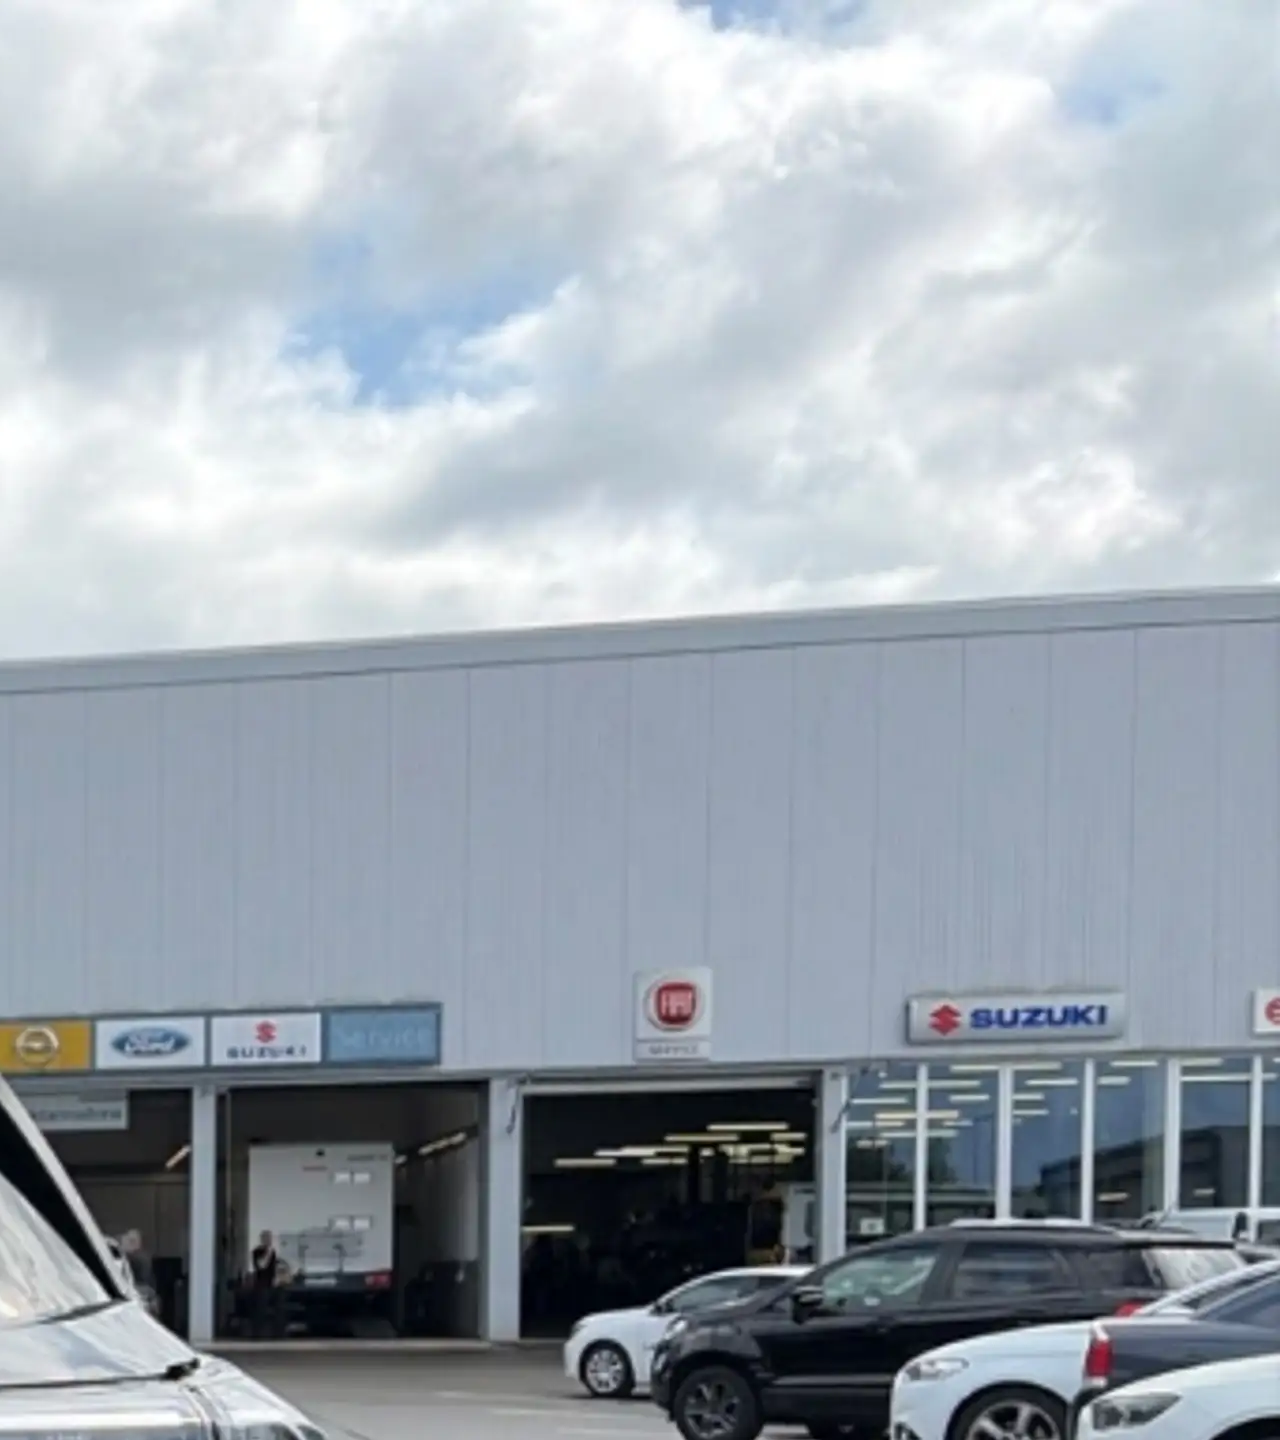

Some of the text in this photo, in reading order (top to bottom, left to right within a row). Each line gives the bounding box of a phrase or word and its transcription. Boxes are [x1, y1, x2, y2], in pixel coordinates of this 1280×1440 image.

[969, 1004, 1109, 1029] SUZUKI
[124, 1028, 176, 1055] Ford
[225, 1045, 308, 1060] SUZUKI
